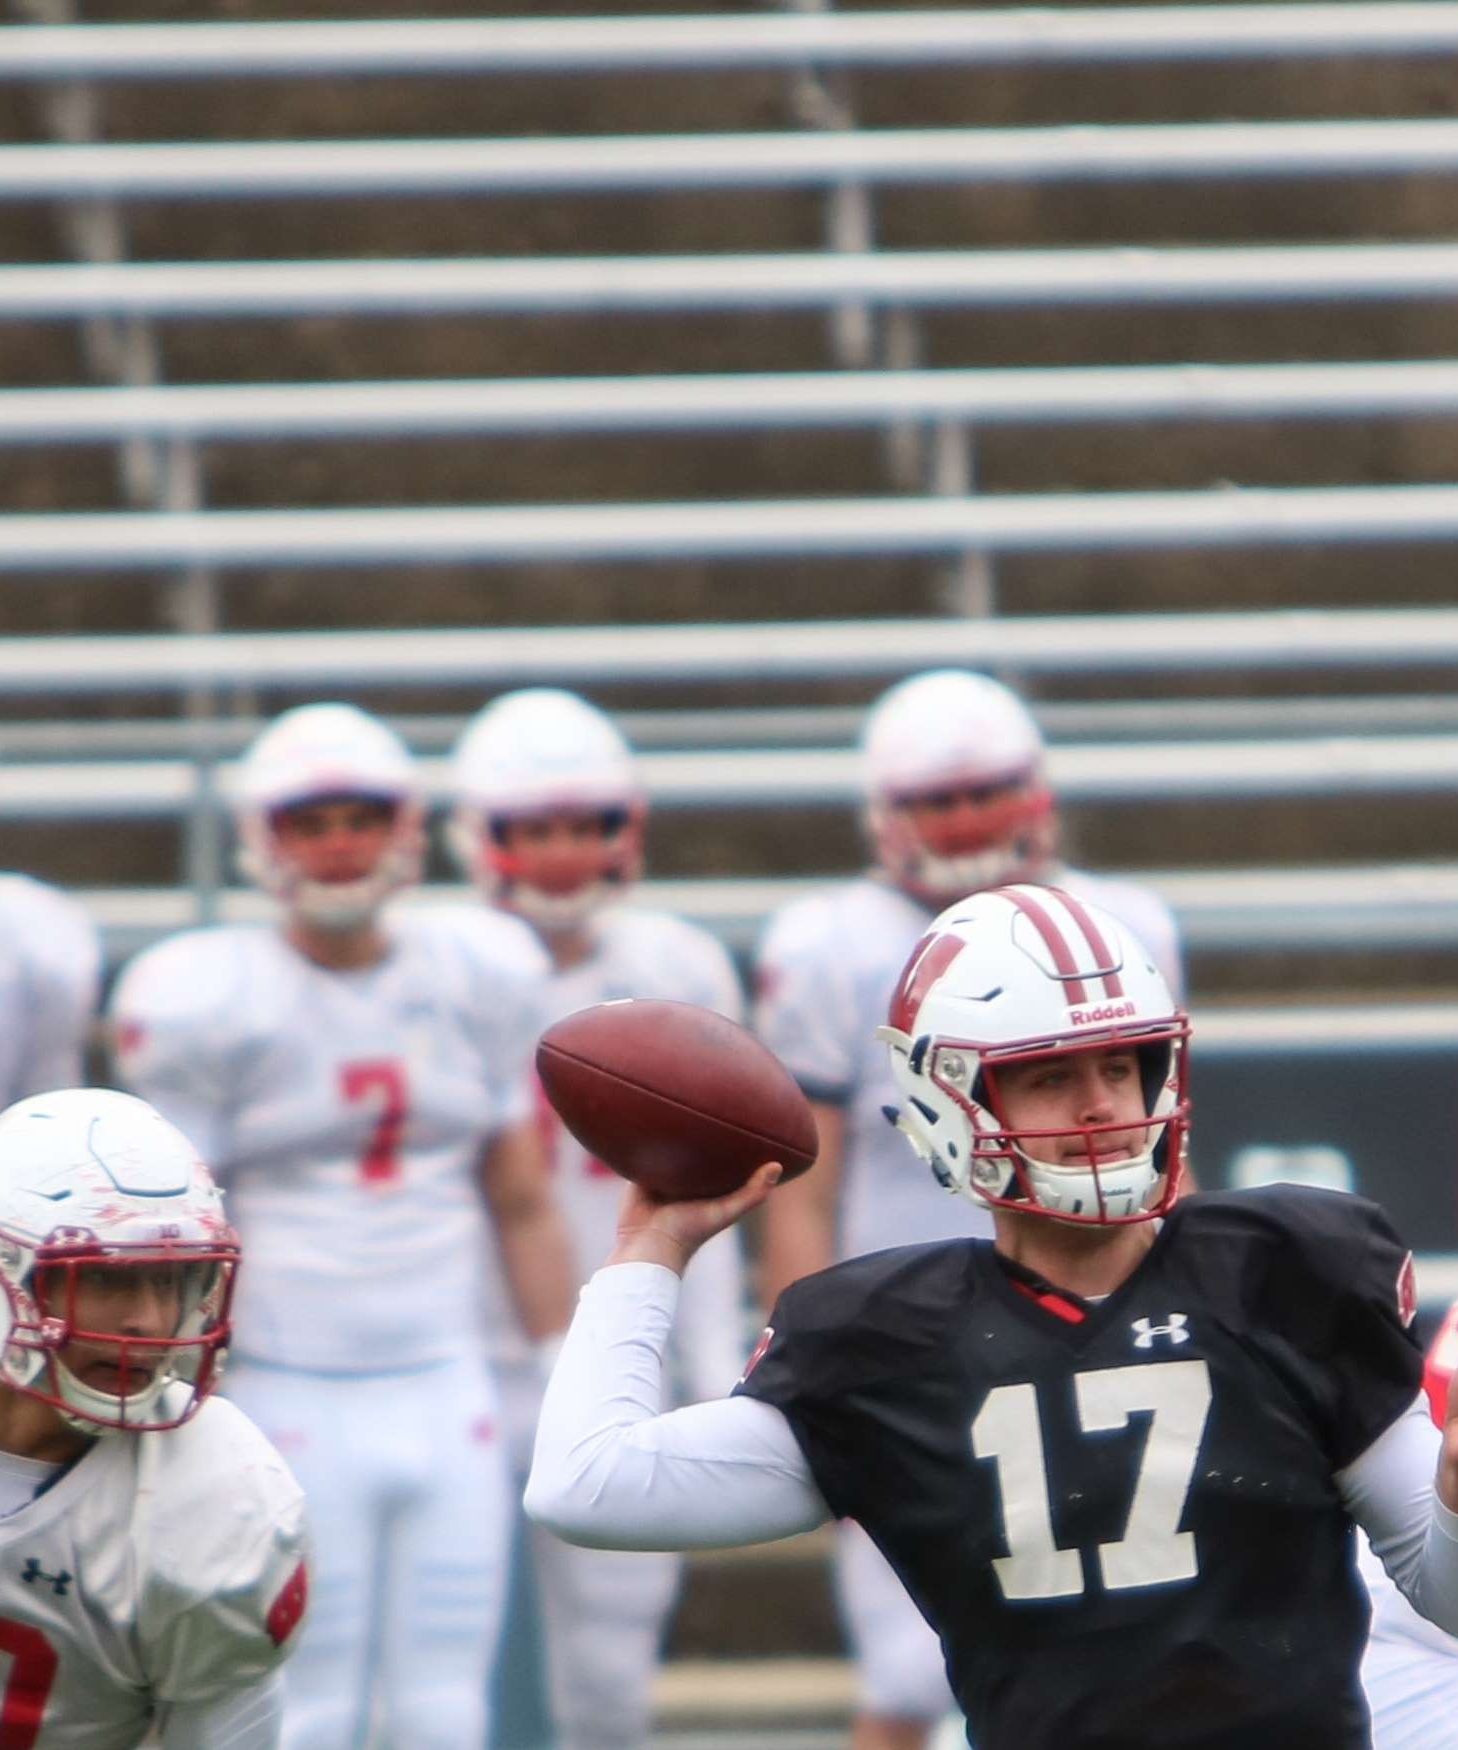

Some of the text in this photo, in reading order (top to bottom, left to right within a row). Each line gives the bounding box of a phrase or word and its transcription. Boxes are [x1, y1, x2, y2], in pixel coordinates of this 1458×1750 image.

[1070, 1001, 1136, 1026] Riddell
[341, 1062, 405, 1180] 7
[972, 1360, 1212, 1599] 17
